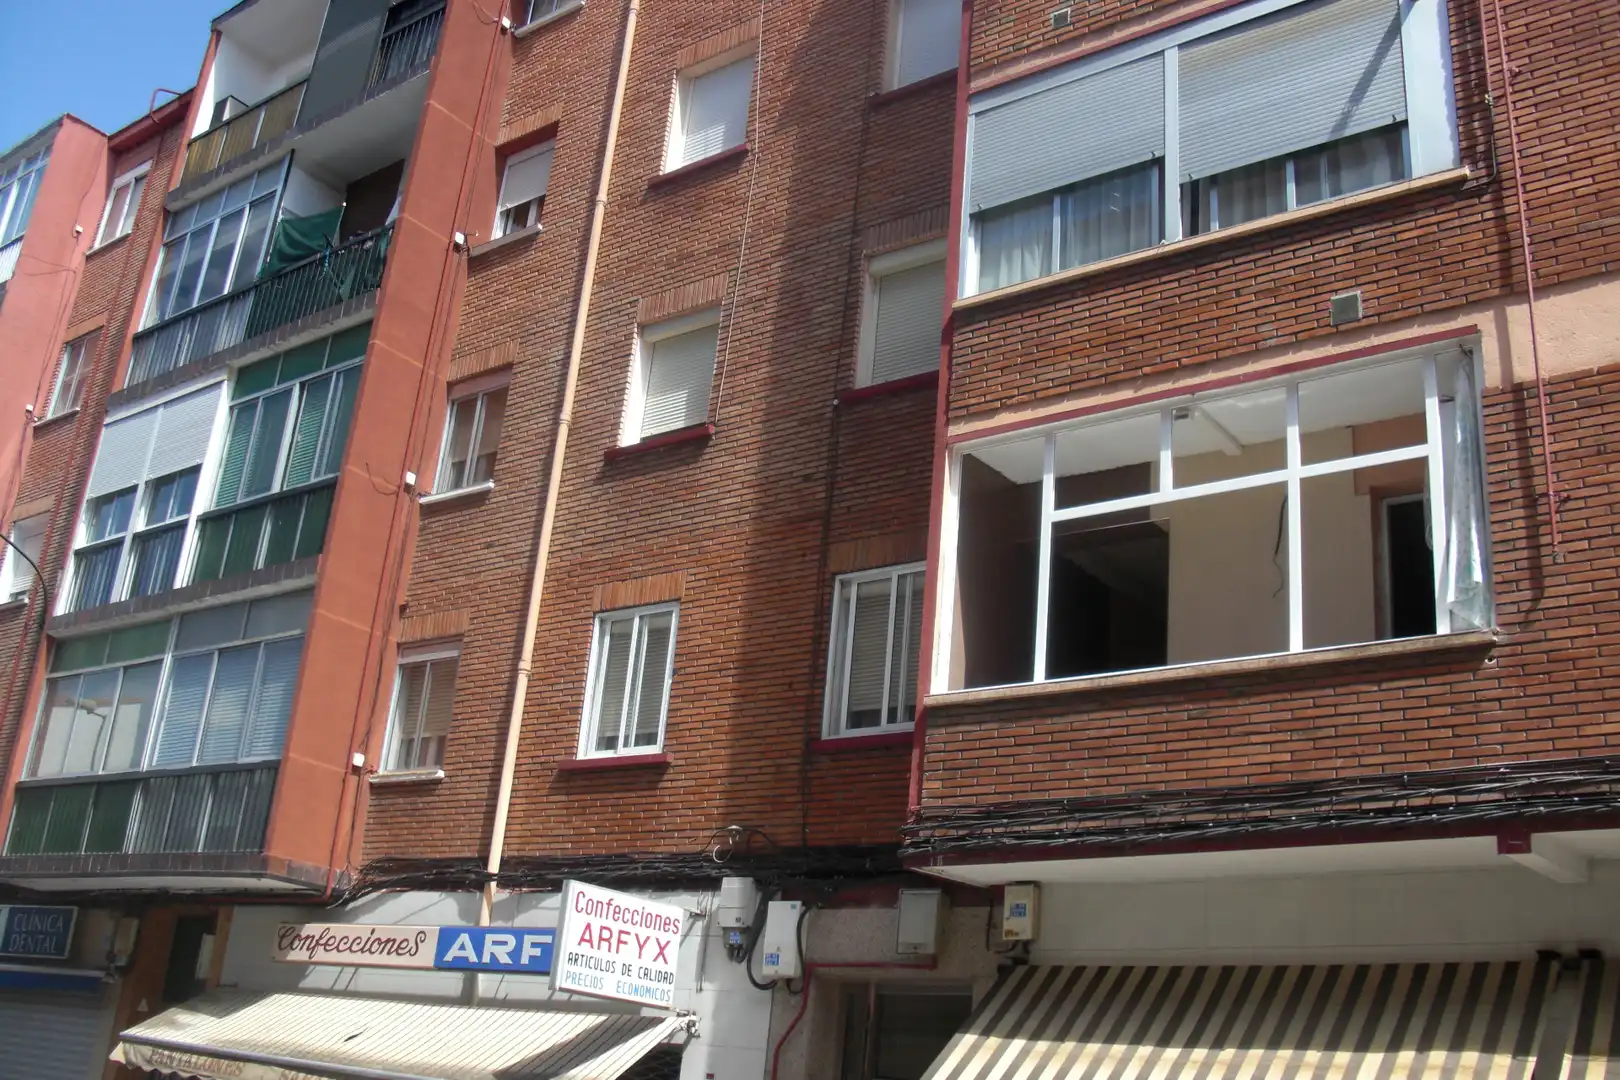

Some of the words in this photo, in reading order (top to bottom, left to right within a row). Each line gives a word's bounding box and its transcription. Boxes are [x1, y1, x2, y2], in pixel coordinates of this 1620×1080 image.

[576, 890, 681, 935] Confecciones
[8, 933, 57, 954] DENTAL
[442, 932, 553, 966] ARF
[577, 922, 672, 965] ARFYX
[565, 969, 604, 990] PRECIOS
[616, 980, 672, 1002] ECONOMICOS
[567, 951, 616, 974] ARTICULOS
[621, 963, 633, 978] DE
[638, 966, 675, 986] CALIDAD
